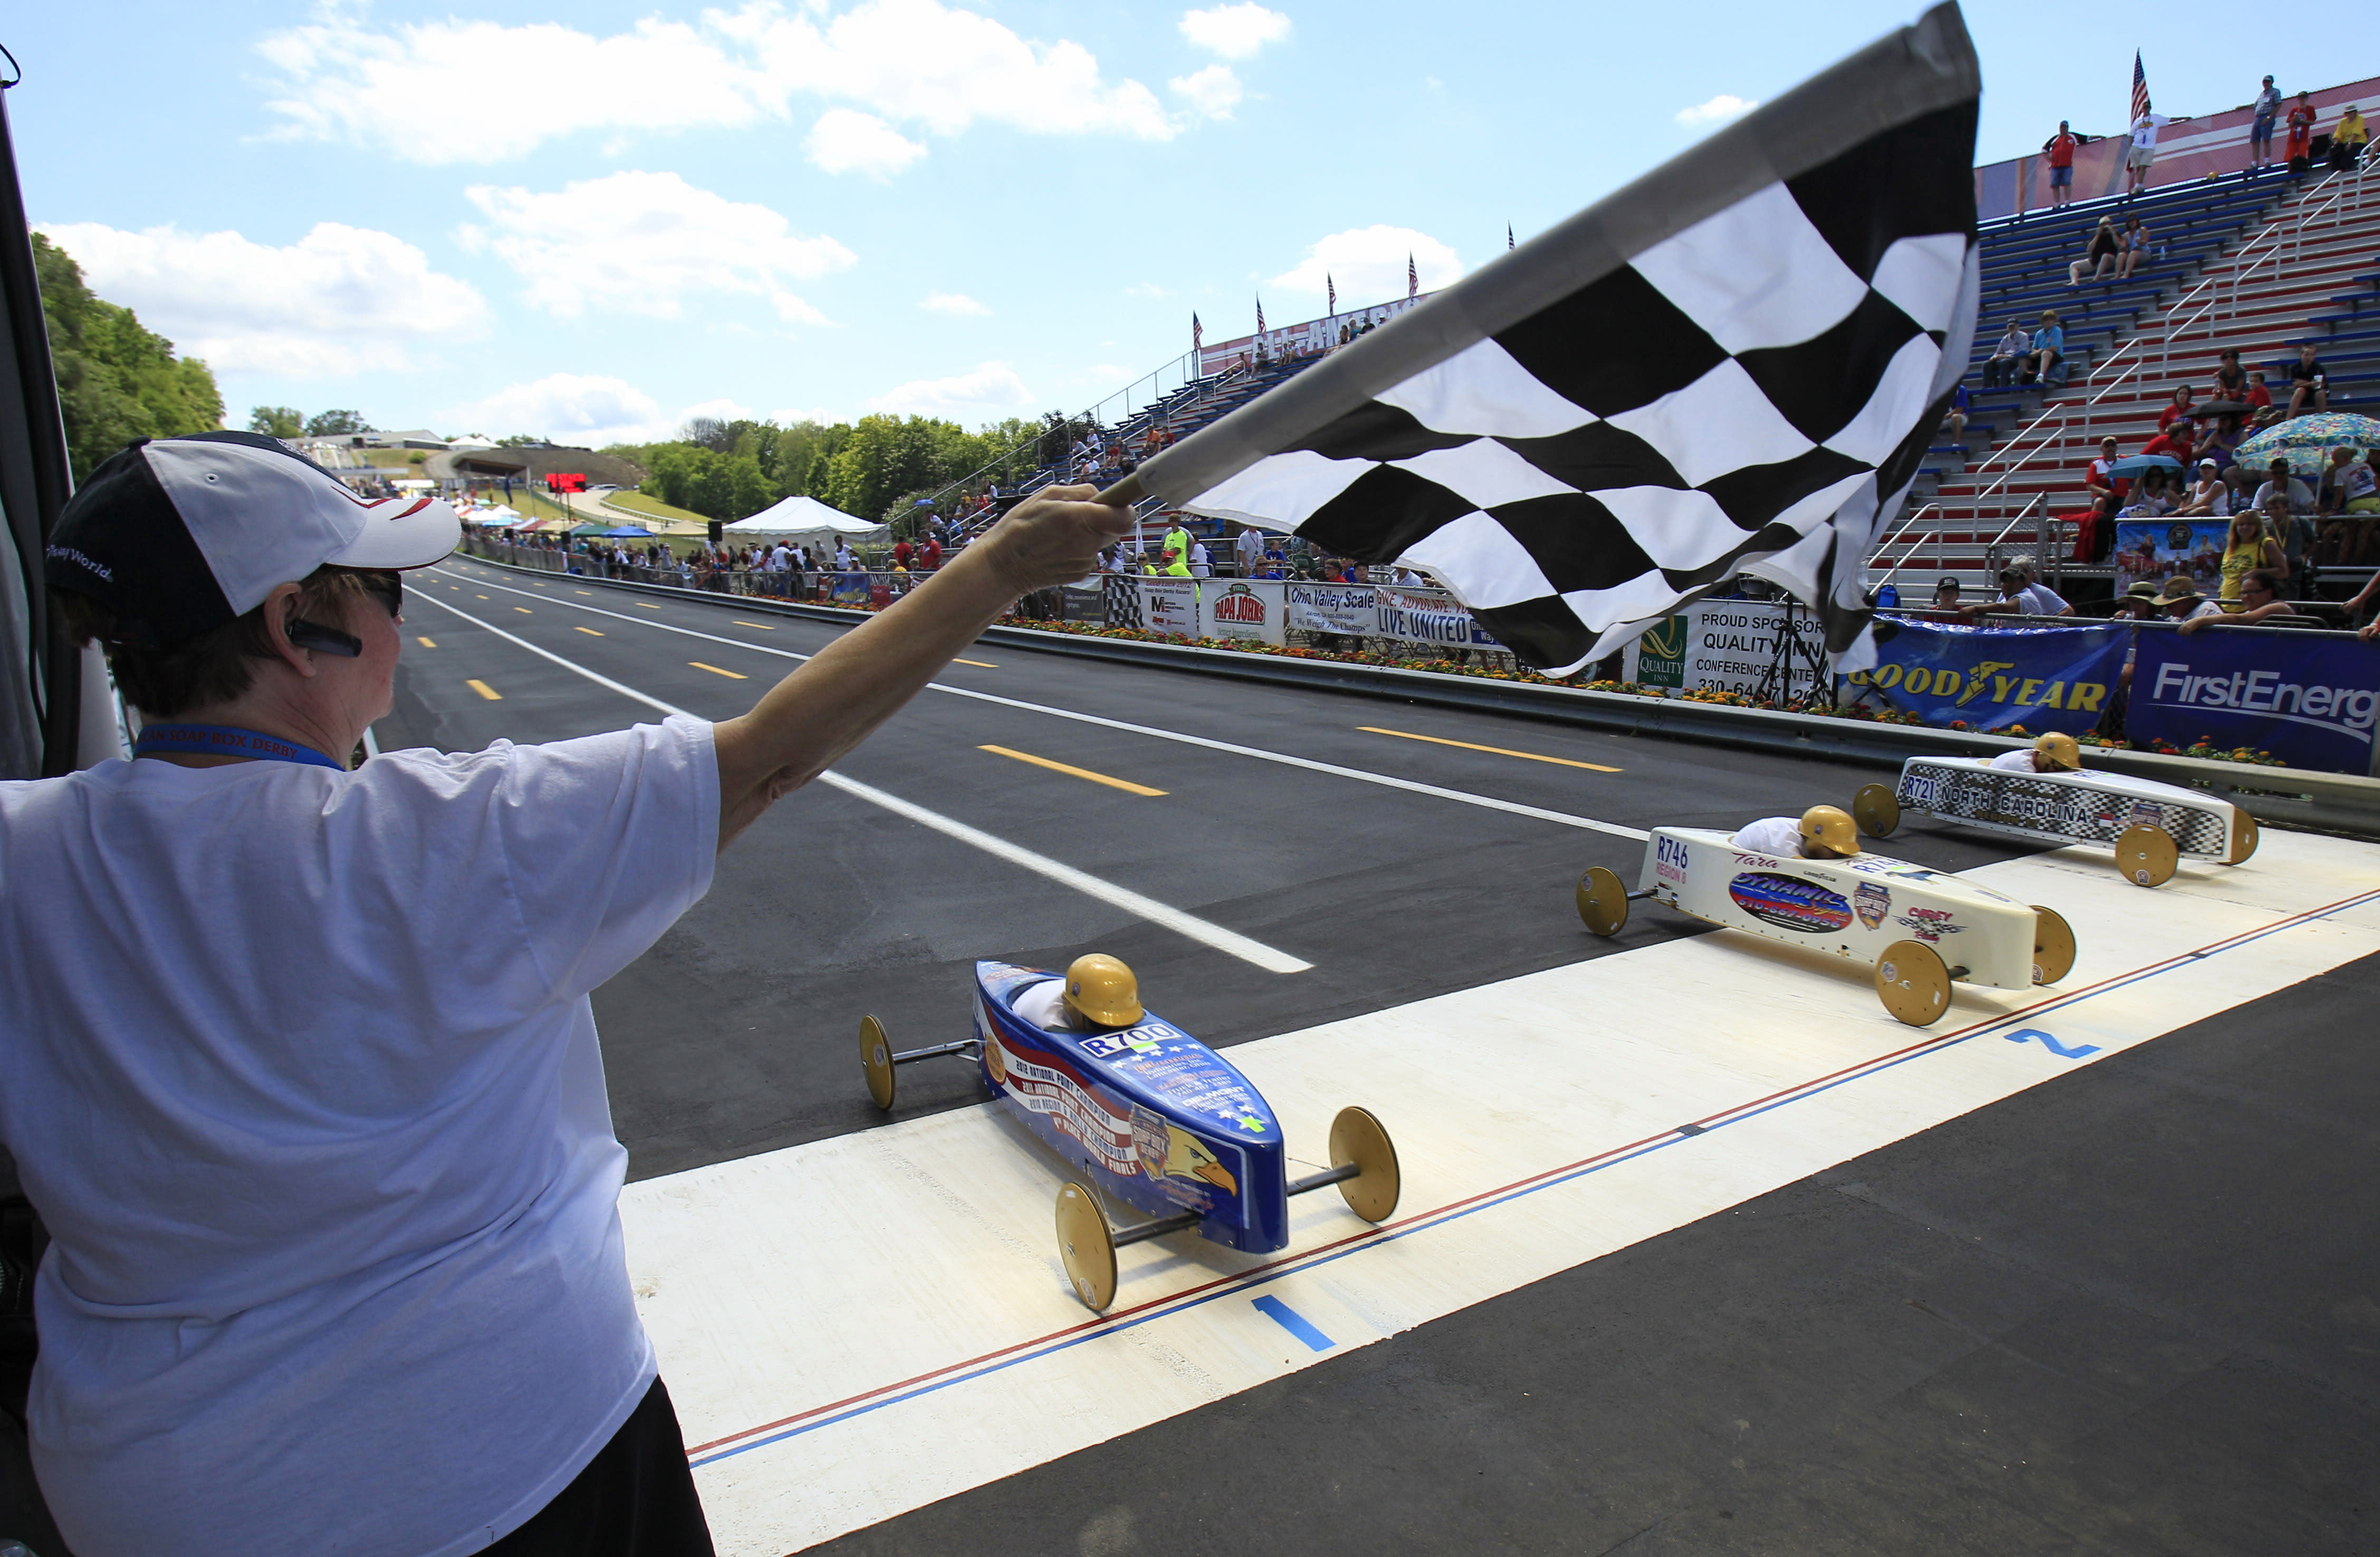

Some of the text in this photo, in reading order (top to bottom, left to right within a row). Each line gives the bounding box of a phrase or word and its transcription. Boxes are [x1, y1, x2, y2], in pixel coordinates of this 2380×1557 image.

[72, 549, 112, 578] World
[1216, 597, 1235, 619] PAPA
[1292, 587, 1374, 612] Ohio Valley Scale
[1377, 590, 1397, 607] GIVE.
[1400, 594, 1452, 613] ADVOCATE.
[1307, 618, 1325, 629] Weigh
[1327, 621, 1339, 630] The
[1340, 623, 1370, 633] Champs"
[1378, 607, 1466, 642] LIVE UNITED
[1481, 632, 1494, 643] Way
[1702, 614, 1825, 633] PROUD SPOSOR
[1704, 633, 1777, 654] QUALITY
[1640, 657, 1684, 674] QUALITY
[1696, 659, 1769, 677] CONFERENCE
[168, 729, 205, 743] SOAP
[210, 732, 247, 747] BOX
[252, 737, 298, 760] DERBY
[1907, 774, 1934, 801] R721
[1941, 785, 1991, 809] NORTH
[2001, 794, 2089, 824] CAROLINA
[1657, 836, 1687, 869] R746
[1731, 852, 1779, 868] Tara
[1656, 862, 1686, 884] REGION 8
[1732, 872, 1847, 907] DYNAMIC
[1084, 1025, 1175, 1055] R700
[2004, 1029, 2102, 1059] 2
[1016, 1060, 1110, 1126] 2012 NATIONAL POINT CHAMPION
[1022, 1081, 1034, 1093] 2011
[1034, 1082, 1060, 1098] NATIONAL
[1061, 1090, 1079, 1113] POINT
[1081, 1108, 1117, 1146] CHAMPION
[1029, 1098, 1040, 1109] 2010
[1042, 1098, 1061, 1110] REGION
[1070, 1110, 1088, 1135] RALLY
[1090, 1130, 1127, 1161] CHAMPION
[1063, 1117, 1081, 1140] PLACE
[1082, 1134, 1106, 1165] WORLD
[1108, 1158, 1136, 1175] FINALS
[1251, 1294, 1337, 1352] 1
